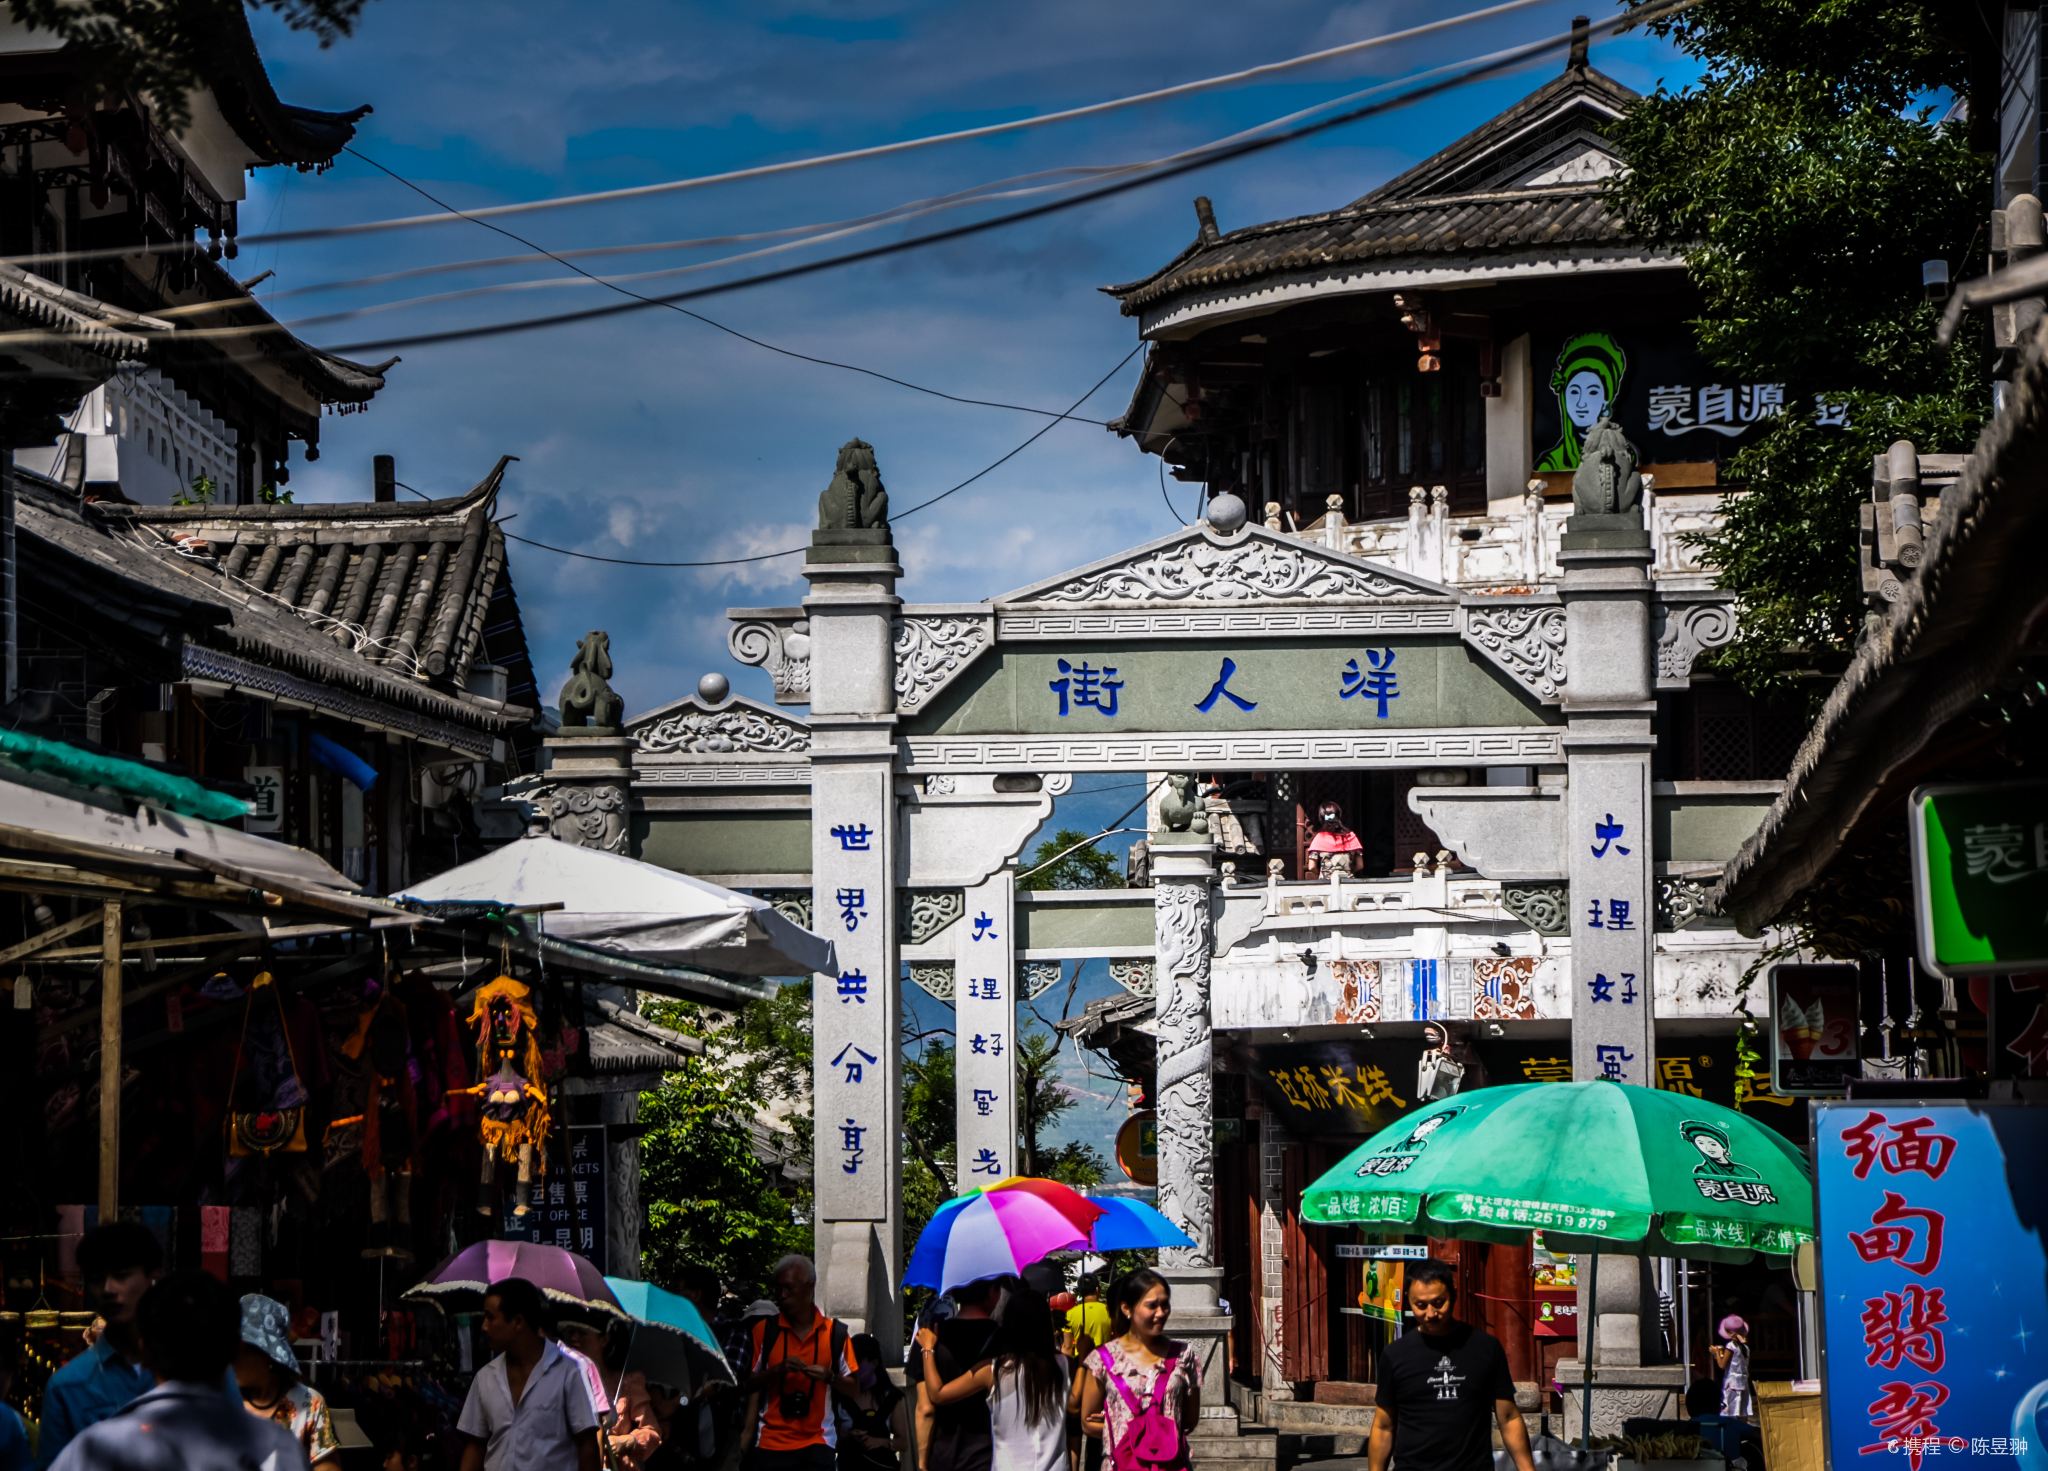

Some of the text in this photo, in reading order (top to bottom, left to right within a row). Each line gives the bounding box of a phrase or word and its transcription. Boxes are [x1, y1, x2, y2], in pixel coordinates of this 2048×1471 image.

[1648, 383, 1785, 436] 蒙自源
[1963, 823, 2048, 885] 蒙
[831, 822, 878, 1174] 世界共分享
[1268, 1064, 1407, 1112] 过桥米线
[1694, 1179, 1776, 1205] 蒙自源
[1841, 1111, 1969, 1471] 缅甸翡翠
